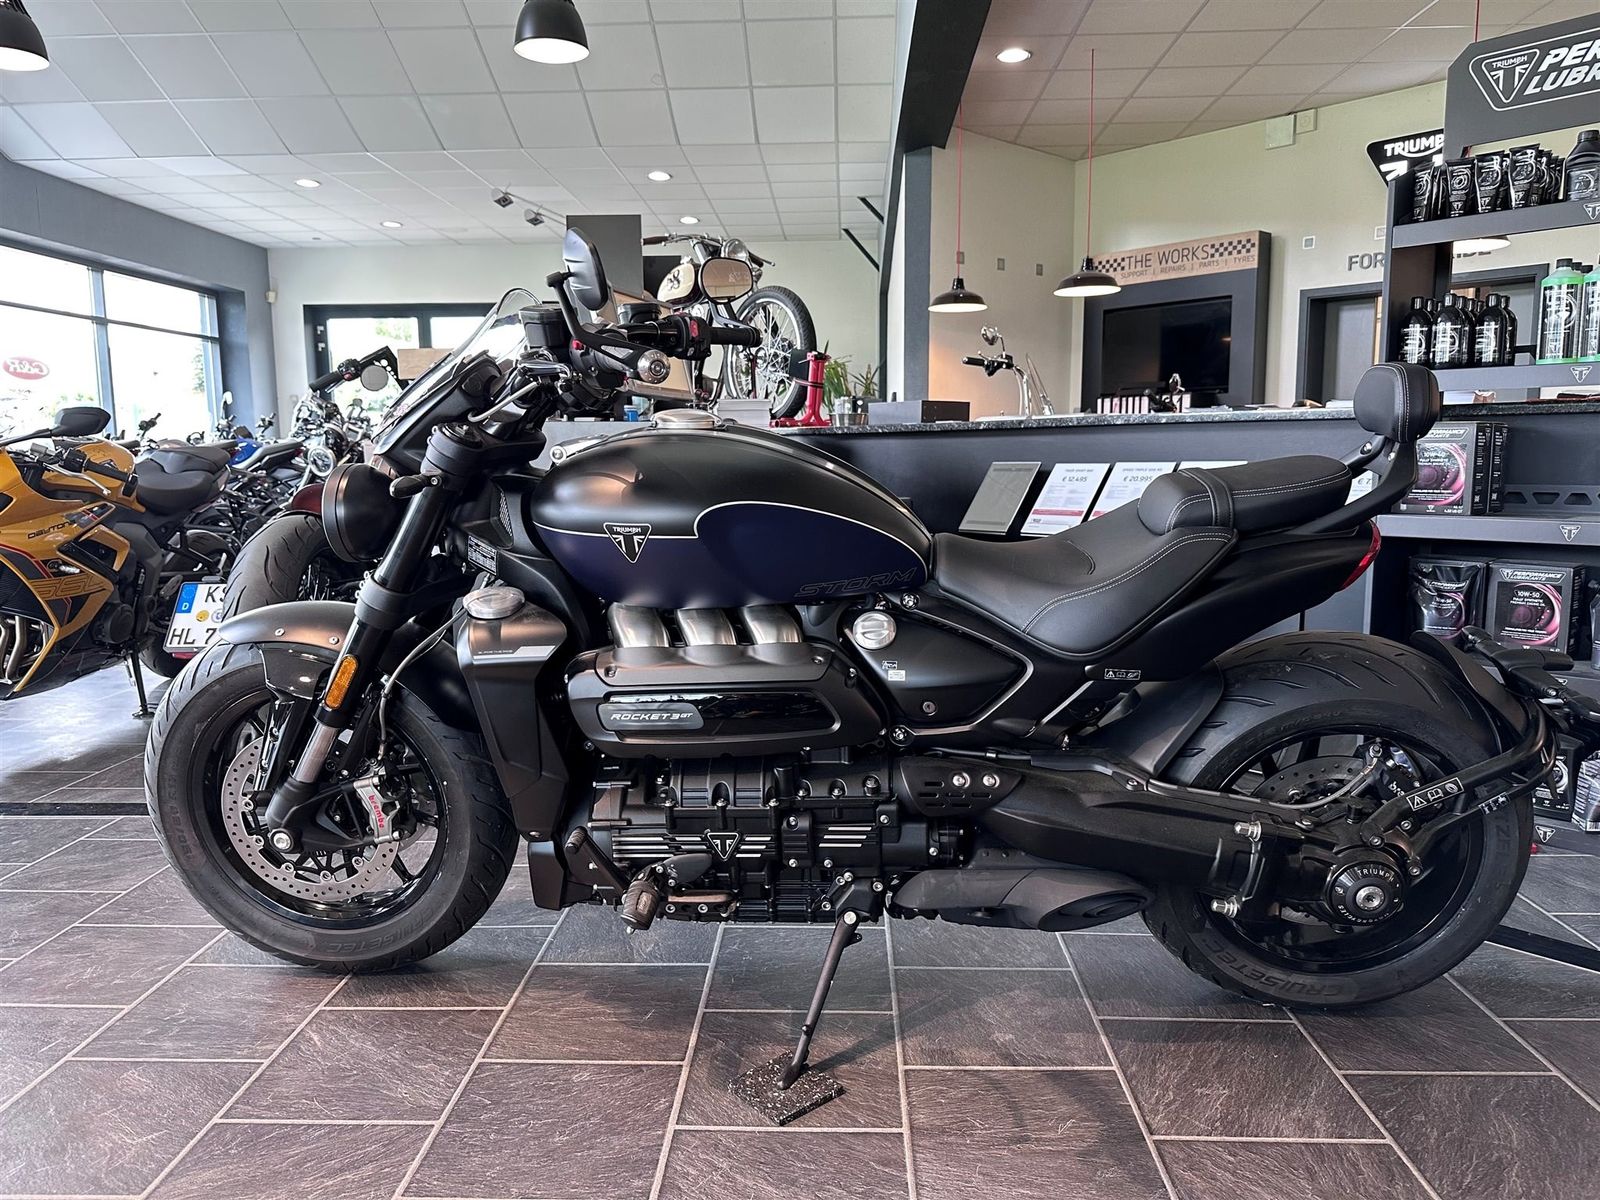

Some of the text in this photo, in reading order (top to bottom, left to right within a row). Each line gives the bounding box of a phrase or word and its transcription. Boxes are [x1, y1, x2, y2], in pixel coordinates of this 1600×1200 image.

[1491, 55, 1528, 69] TRIUMPH
[1383, 133, 1445, 158] TRIUMP
[1120, 255, 1256, 280] SUPPORT REPAIRS PARTS TYRES
[1126, 244, 1210, 270] THE WORKS
[612, 526, 642, 535] TRIUMPH
[794, 567, 918, 597] STORM
[181, 602, 190, 611] D
[169, 628, 196, 646] HL
[368, 794, 385, 829] brembo
[1356, 868, 1395, 883] TRIUMPH
